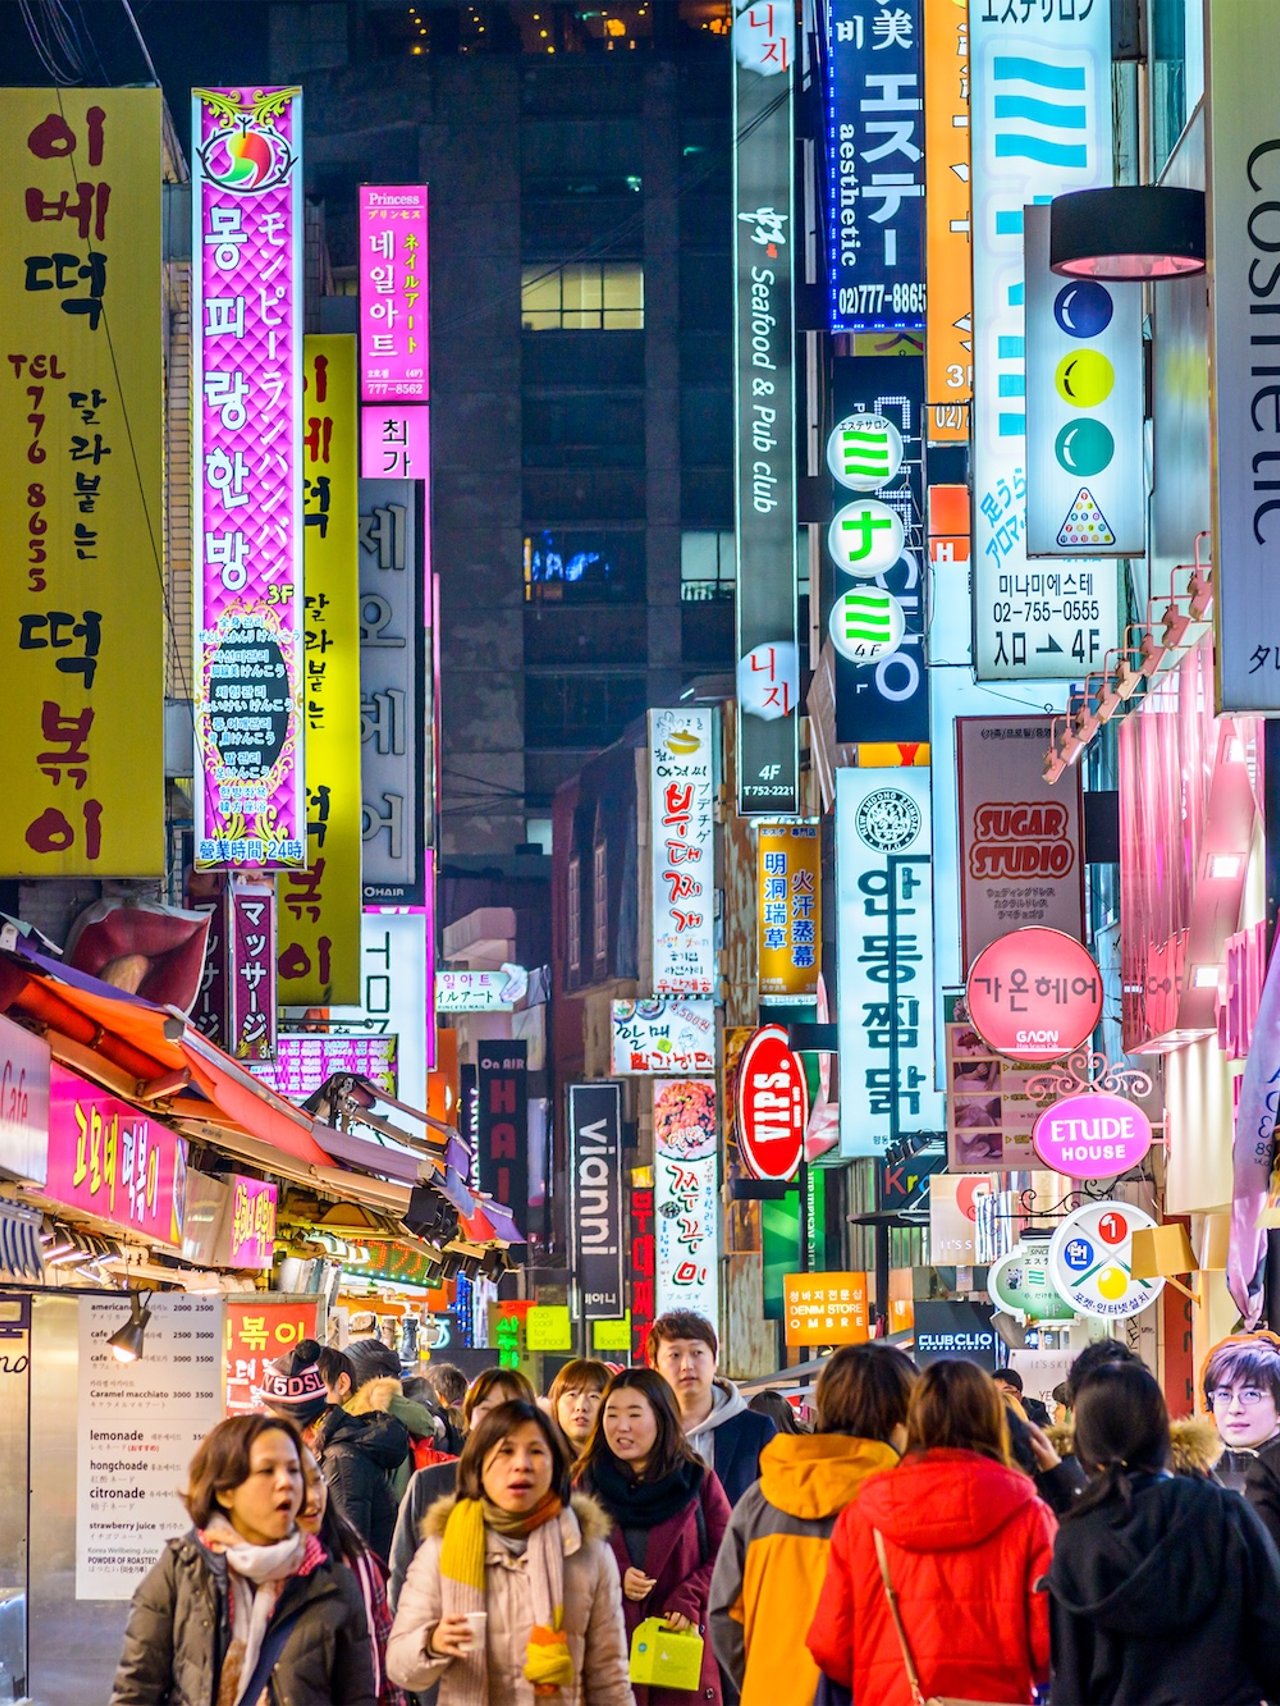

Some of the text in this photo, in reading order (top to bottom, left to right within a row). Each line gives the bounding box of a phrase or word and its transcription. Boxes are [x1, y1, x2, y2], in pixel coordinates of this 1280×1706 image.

[749, 3, 788, 73] 니지
[836, 15, 864, 50] 비
[872, 8, 914, 51] 美
[369, 192, 420, 206] Princess
[839, 123, 859, 267] aesthetic
[368, 210, 421, 220] プリンセス
[368, 229, 400, 357] 네일아트
[403, 233, 420, 355] ネイルアート
[751, 266, 777, 370] Seafood
[8, 355, 66, 379] TEL
[205, 207, 250, 592] 몽피랑한방
[367, 383, 423, 395] 777-8562
[752, 402, 777, 453] Pub
[840, 419, 890, 430] エステサロン
[382, 419, 411, 477] 최가
[753, 461, 778, 514] club
[267, 584, 294, 605] 3F
[999, 573, 1093, 597] 미나미에스테
[993, 600, 1099, 623] 02-755-0555
[994, 629, 1100, 666] 入口 4F
[750, 649, 789, 716] 니지
[19, 612, 102, 860] 떡볶이
[759, 765, 781, 778] 4F
[752, 785, 795, 796] 752-2221
[979, 808, 1062, 837] SUGAR
[663, 783, 703, 932] 부대찌개
[974, 846, 1070, 875] STUDIO
[765, 852, 788, 950] 明洞瑞草
[240, 902, 267, 1042] マッサージ
[974, 966, 1097, 1012] 가온헤어
[481, 1059, 499, 1069] On
[1050, 1117, 1135, 1143] ETUDE
[1061, 1143, 1127, 1161] HOUSE
[579, 1118, 617, 1256] vianni
[90, 1303, 134, 1311] american
[790, 1303, 863, 1315] DENIM STORE
[90, 1389, 124, 1399] Caramel
[126, 1390, 169, 1399] macchiato
[90, 1430, 144, 1441] lemonade
[90, 1460, 149, 1473] hongchoade
[89, 1487, 146, 1499] citronade
[89, 1522, 135, 1532] strawberry
[136, 1521, 156, 1533] juice
